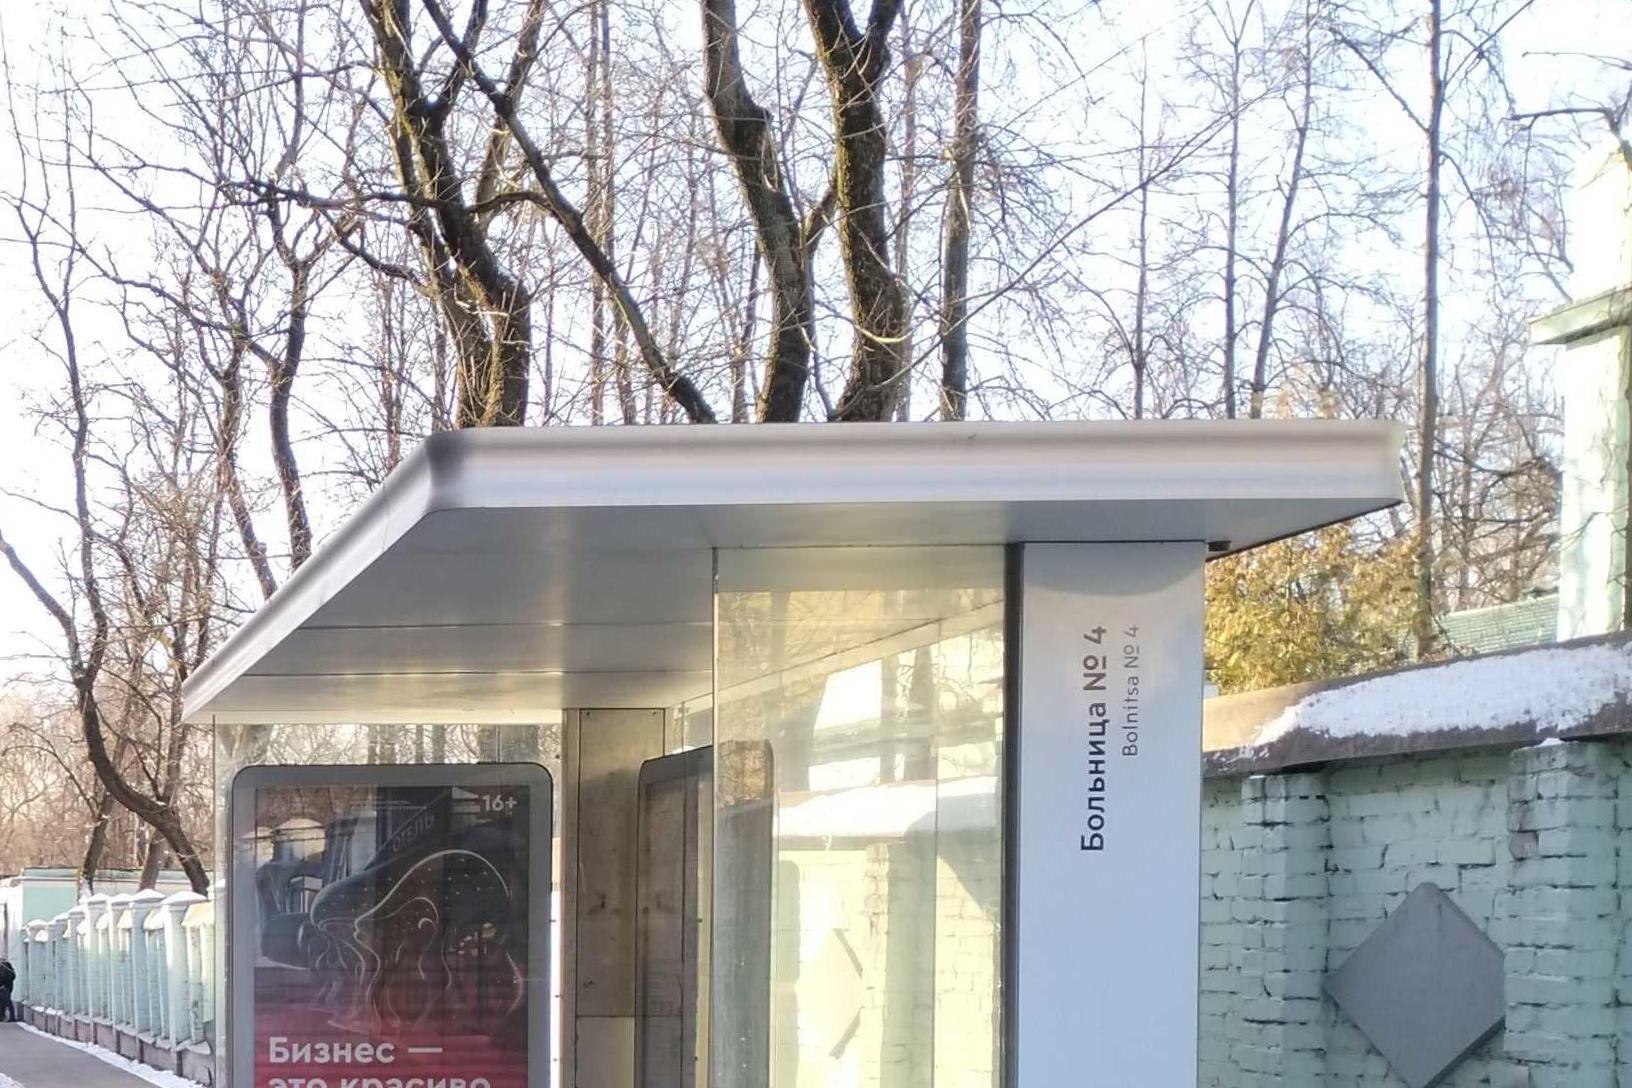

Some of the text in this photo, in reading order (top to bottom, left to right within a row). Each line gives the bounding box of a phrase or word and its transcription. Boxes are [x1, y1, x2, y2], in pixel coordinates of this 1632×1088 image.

[1084, 626, 1107, 644] 4
[1124, 625, 1140, 638] 4
[1122, 676, 1140, 756] Bolnitsa
[1080, 702, 1109, 851] Больница
[482, 794, 517, 812] 16+
[269, 1036, 395, 1063] Бизнес
